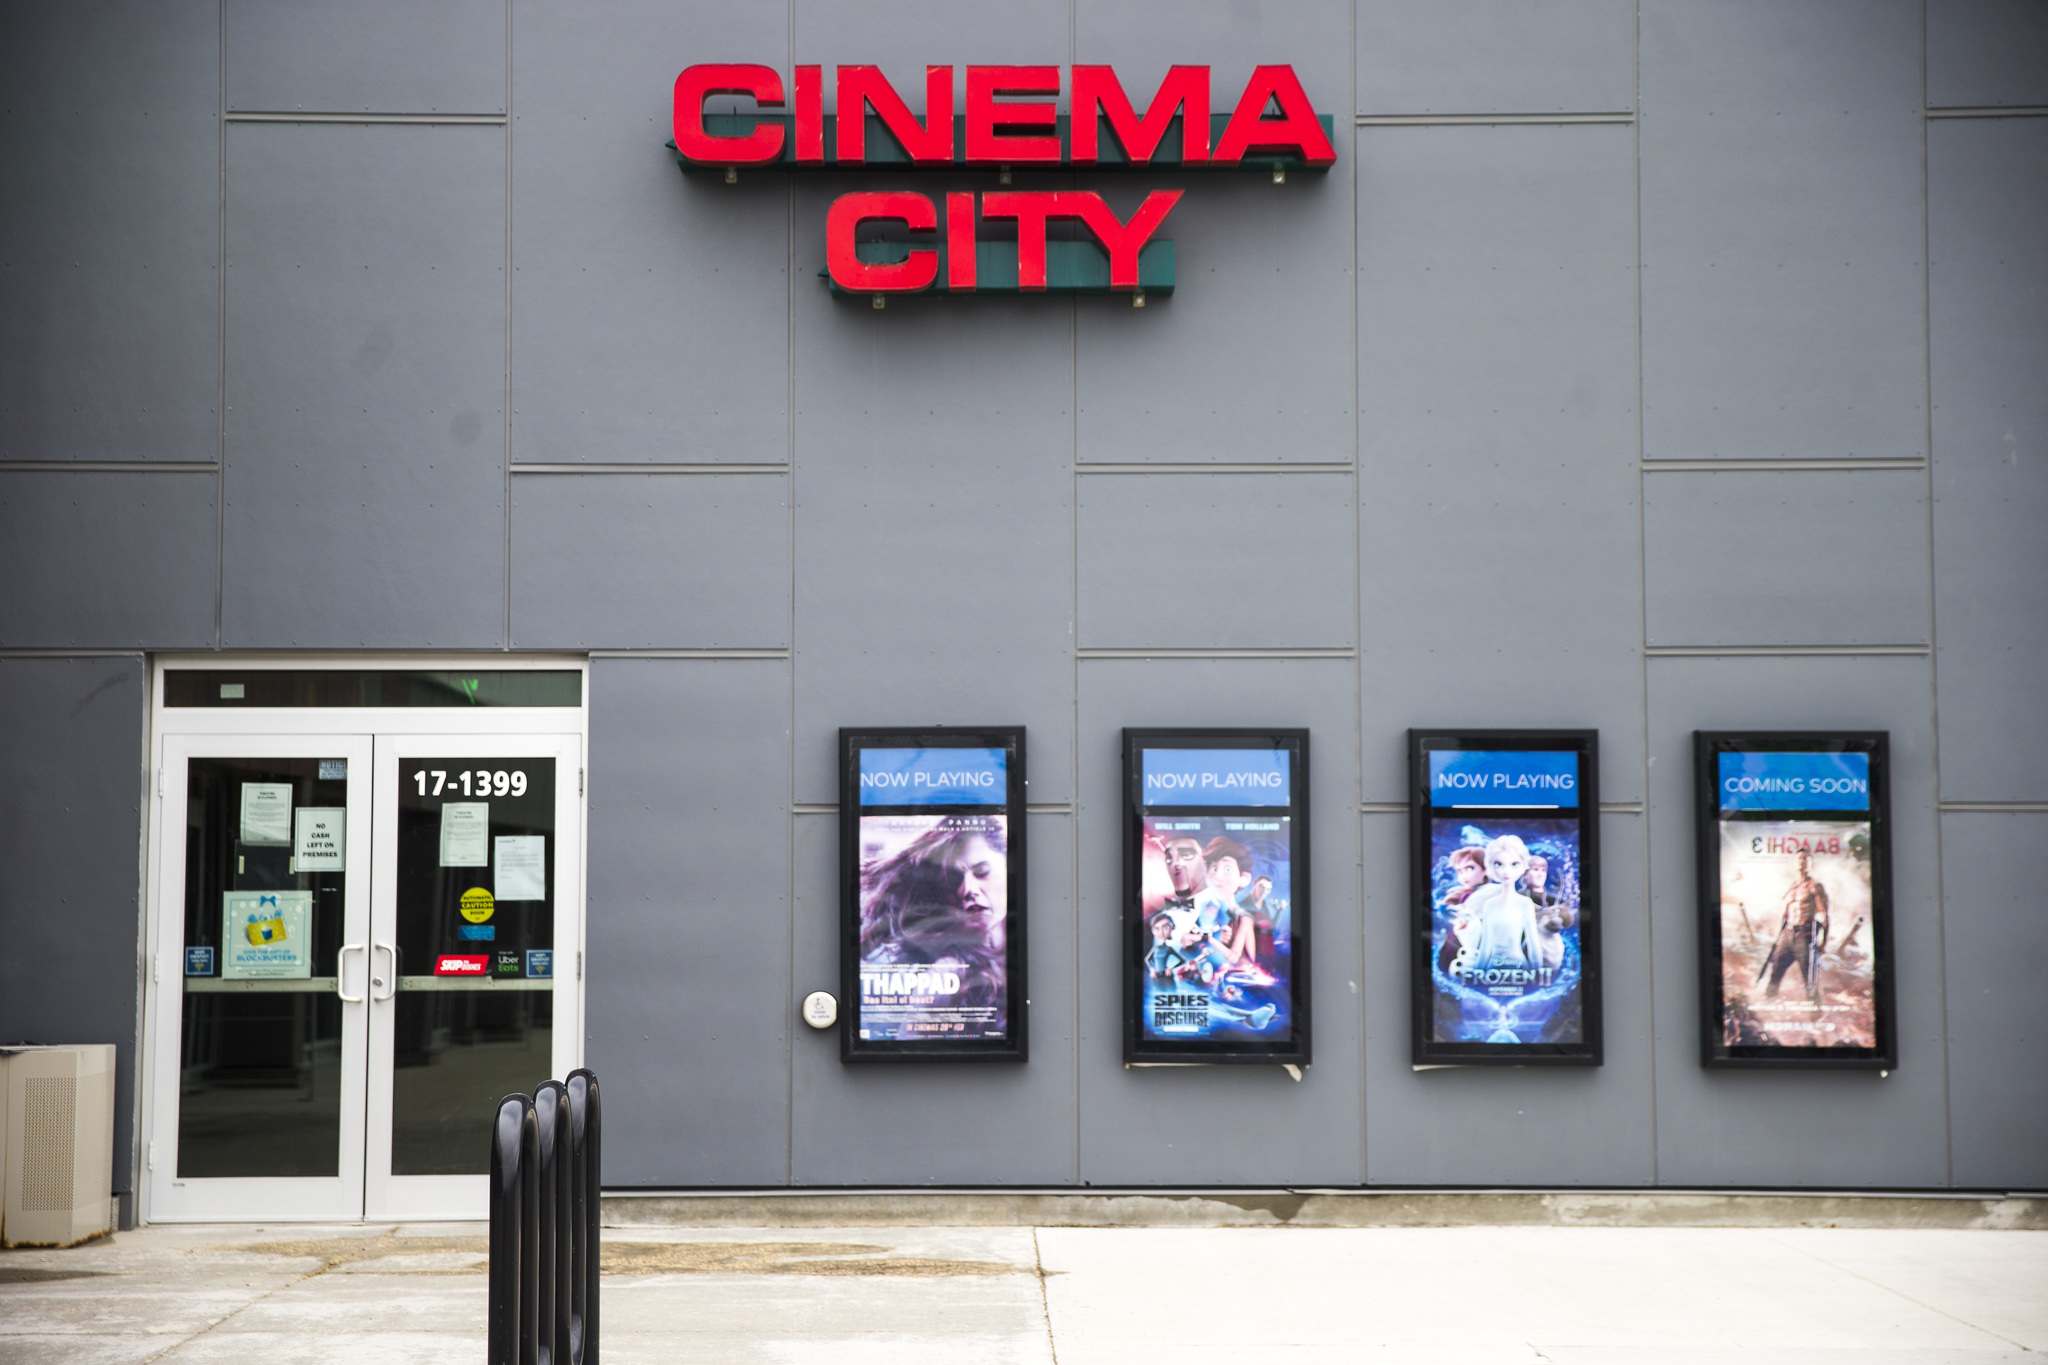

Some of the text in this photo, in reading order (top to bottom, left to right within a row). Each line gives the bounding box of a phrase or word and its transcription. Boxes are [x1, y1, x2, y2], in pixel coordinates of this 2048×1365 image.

[673, 64, 1337, 165] CINEMA
[826, 189, 1185, 293] CITY
[413, 770, 528, 797] 17-1399
[860, 771, 995, 788] NOW PLAYING
[1147, 772, 1282, 789] NOW PLAYING
[1438, 773, 1575, 790] NOW PLAYING
[1724, 777, 1867, 794] COMING SOON
[498, 955, 519, 963] Uber
[860, 973, 960, 995] THAPPAD
[1463, 967, 1553, 986] FROZEN II
[1154, 994, 1209, 1007] SPIES
[1154, 1011, 1209, 1027] DISGUISE
